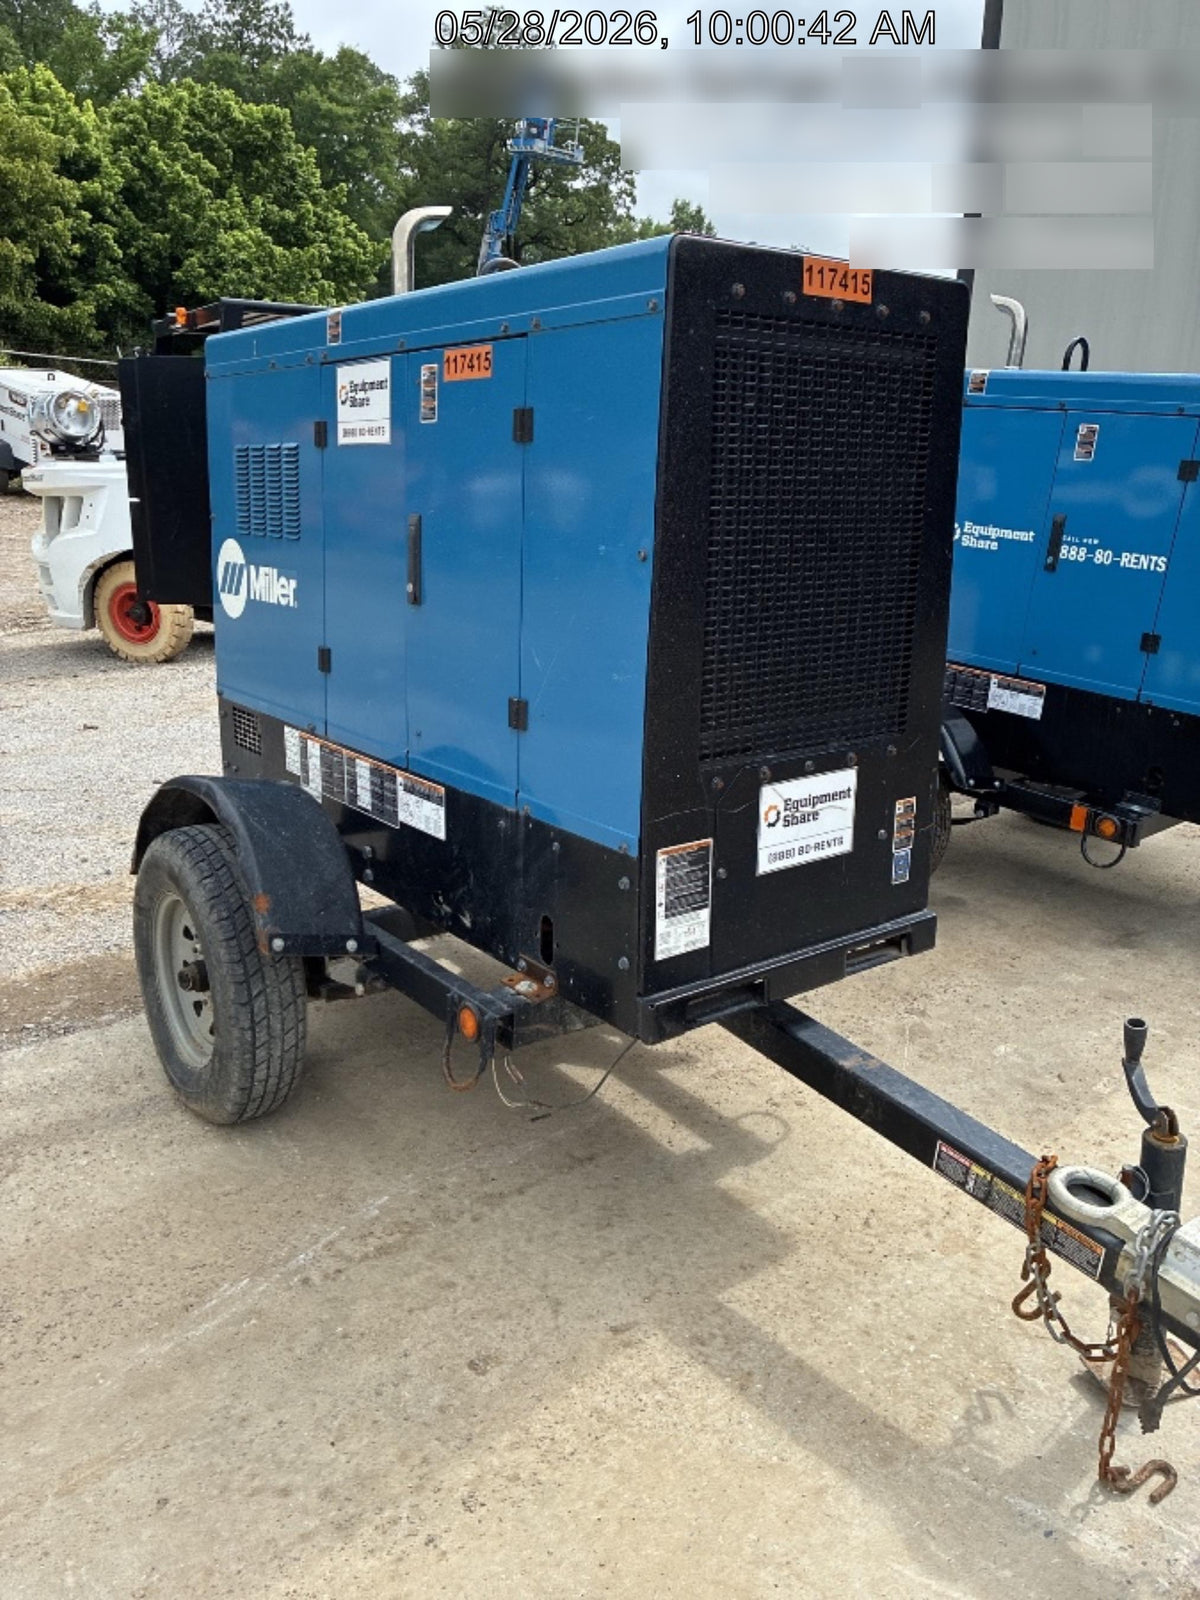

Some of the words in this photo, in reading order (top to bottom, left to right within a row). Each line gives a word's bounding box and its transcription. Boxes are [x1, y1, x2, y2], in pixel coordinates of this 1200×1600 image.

[805, 264, 870, 296] 117415
[444, 351, 491, 375] 117415
[961, 534, 998, 550] Share
[963, 521, 1035, 542] Equipment
[1059, 544, 1167, 572] 888-80-RENTS
[249, 564, 297, 608] Miller
[783, 787, 852, 813] Equipment
[782, 810, 820, 828] Share
